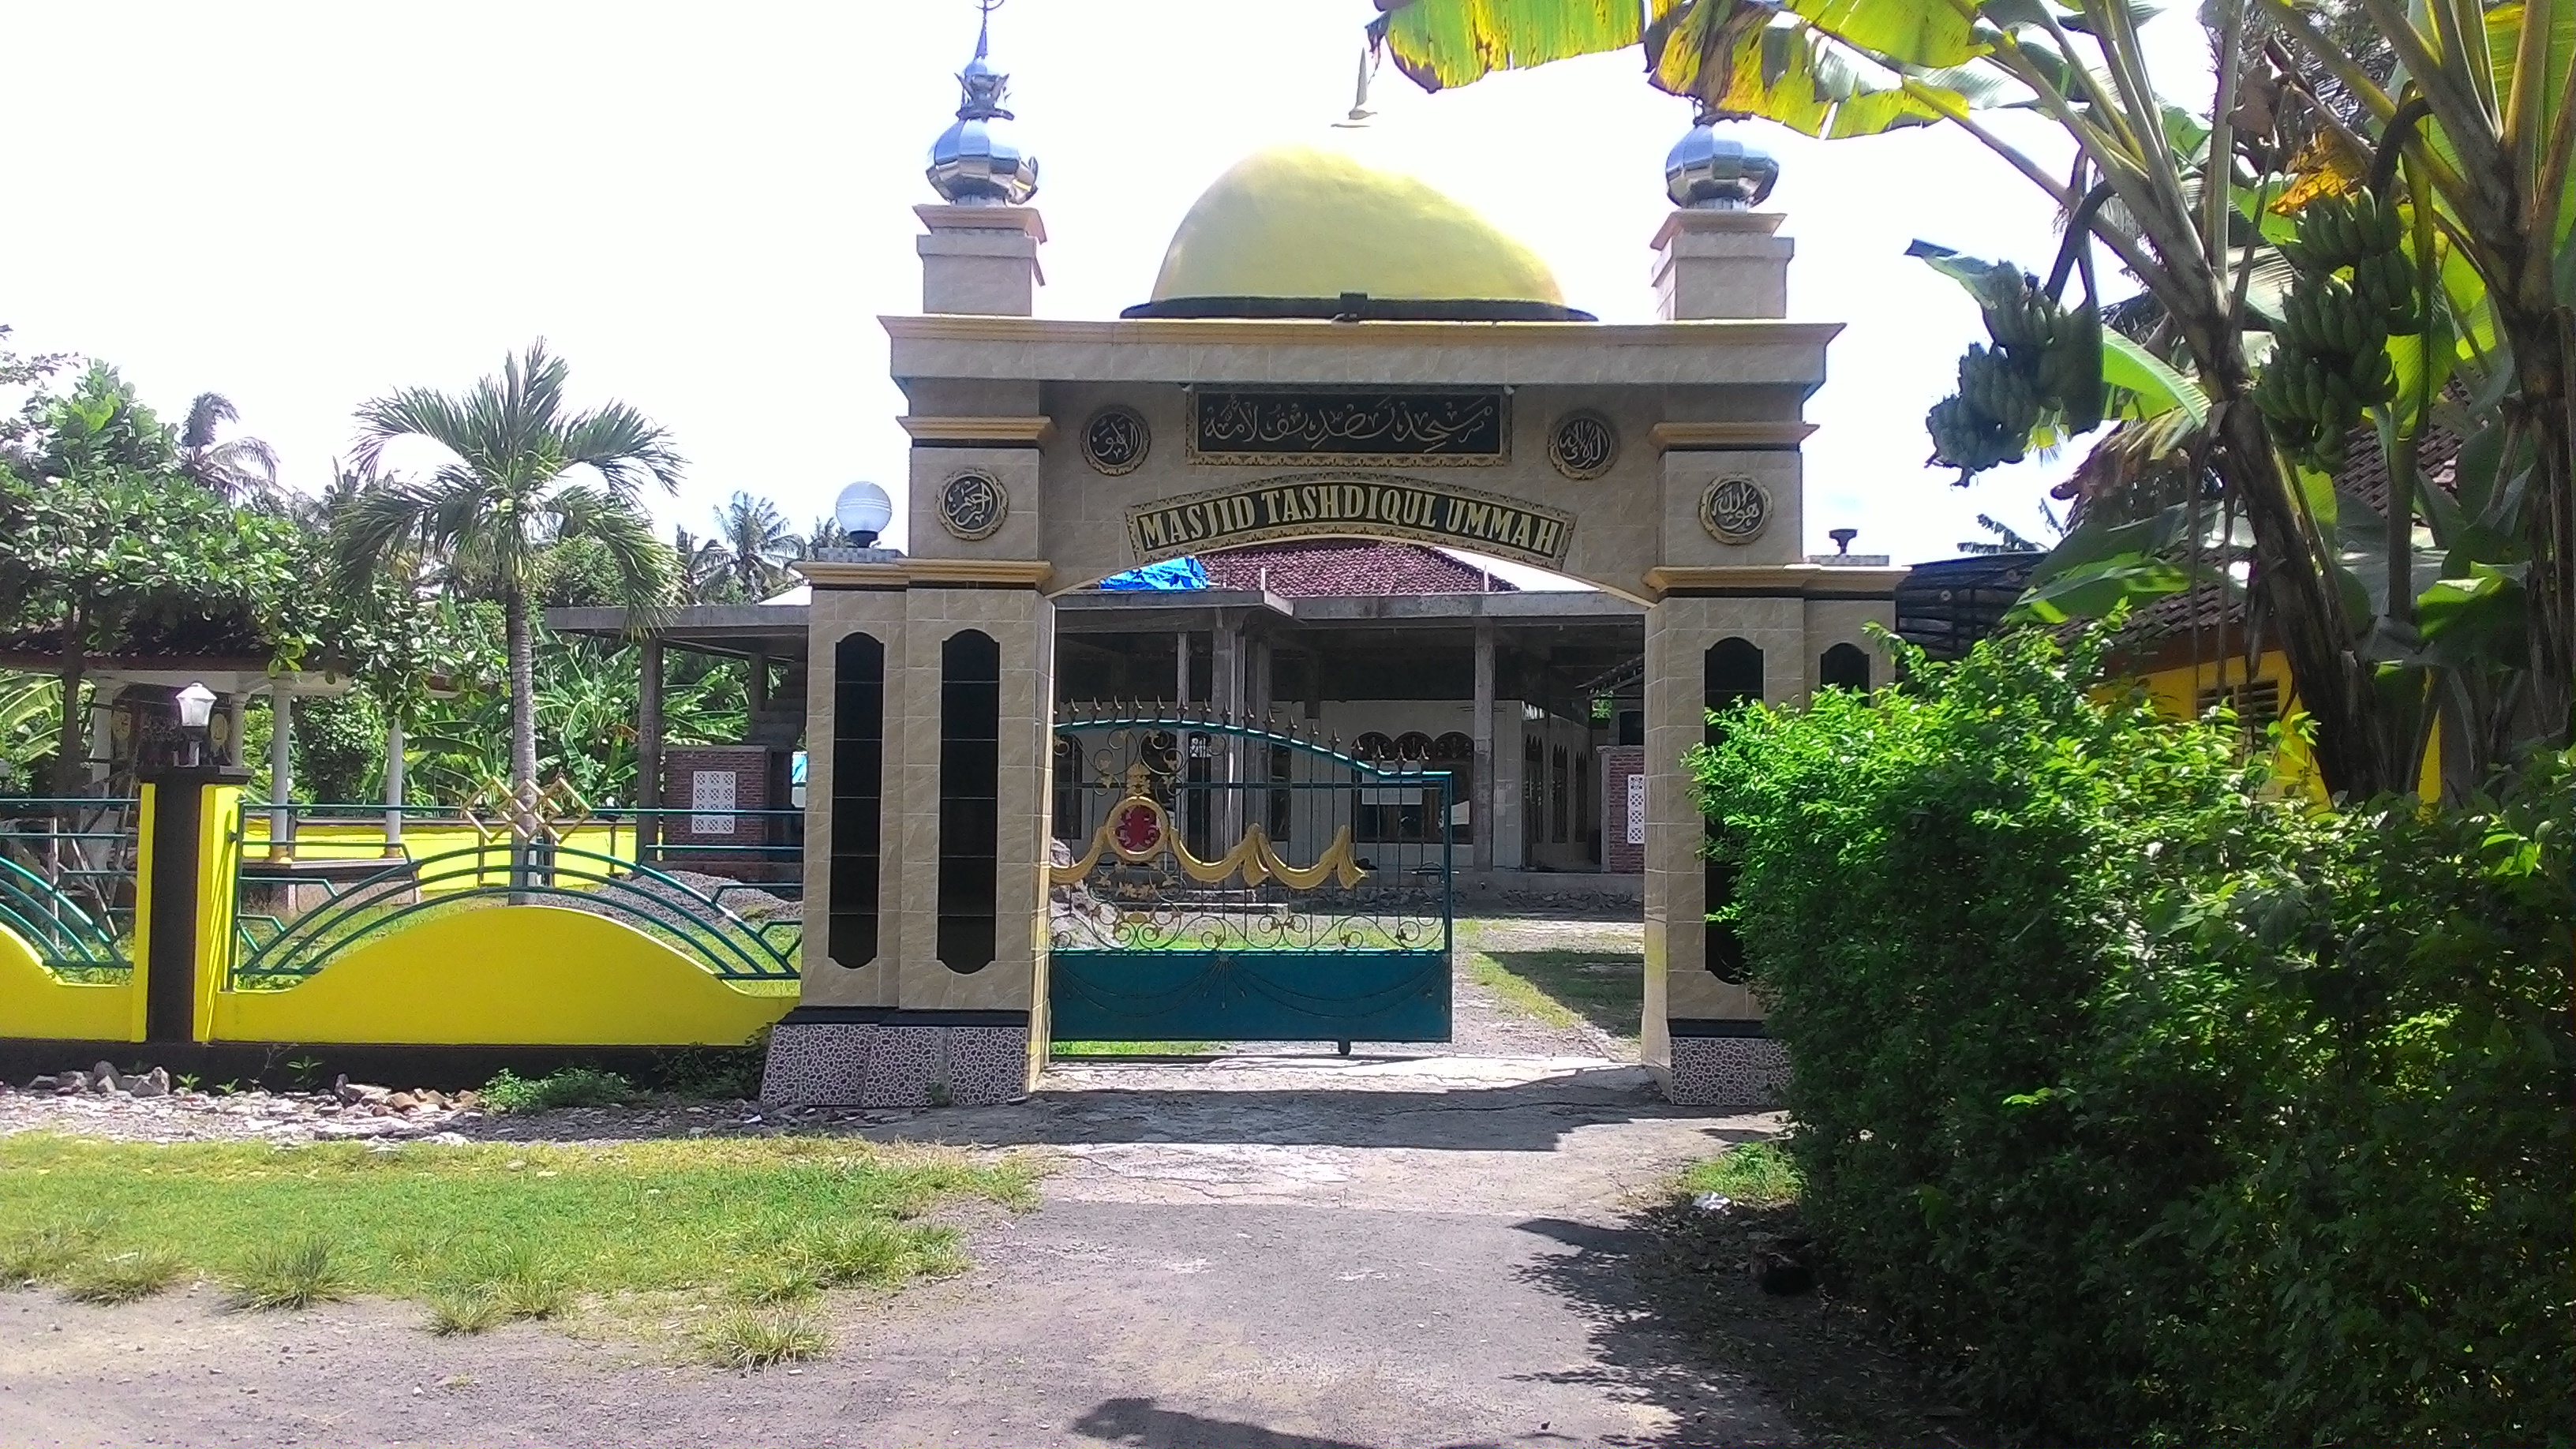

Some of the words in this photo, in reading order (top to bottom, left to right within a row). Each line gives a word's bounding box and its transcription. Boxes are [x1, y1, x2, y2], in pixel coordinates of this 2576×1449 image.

[1139, 496, 1256, 548] MASJID
[1261, 485, 1437, 526] TASHDIQUL
[1447, 498, 1560, 555] UMMAH
